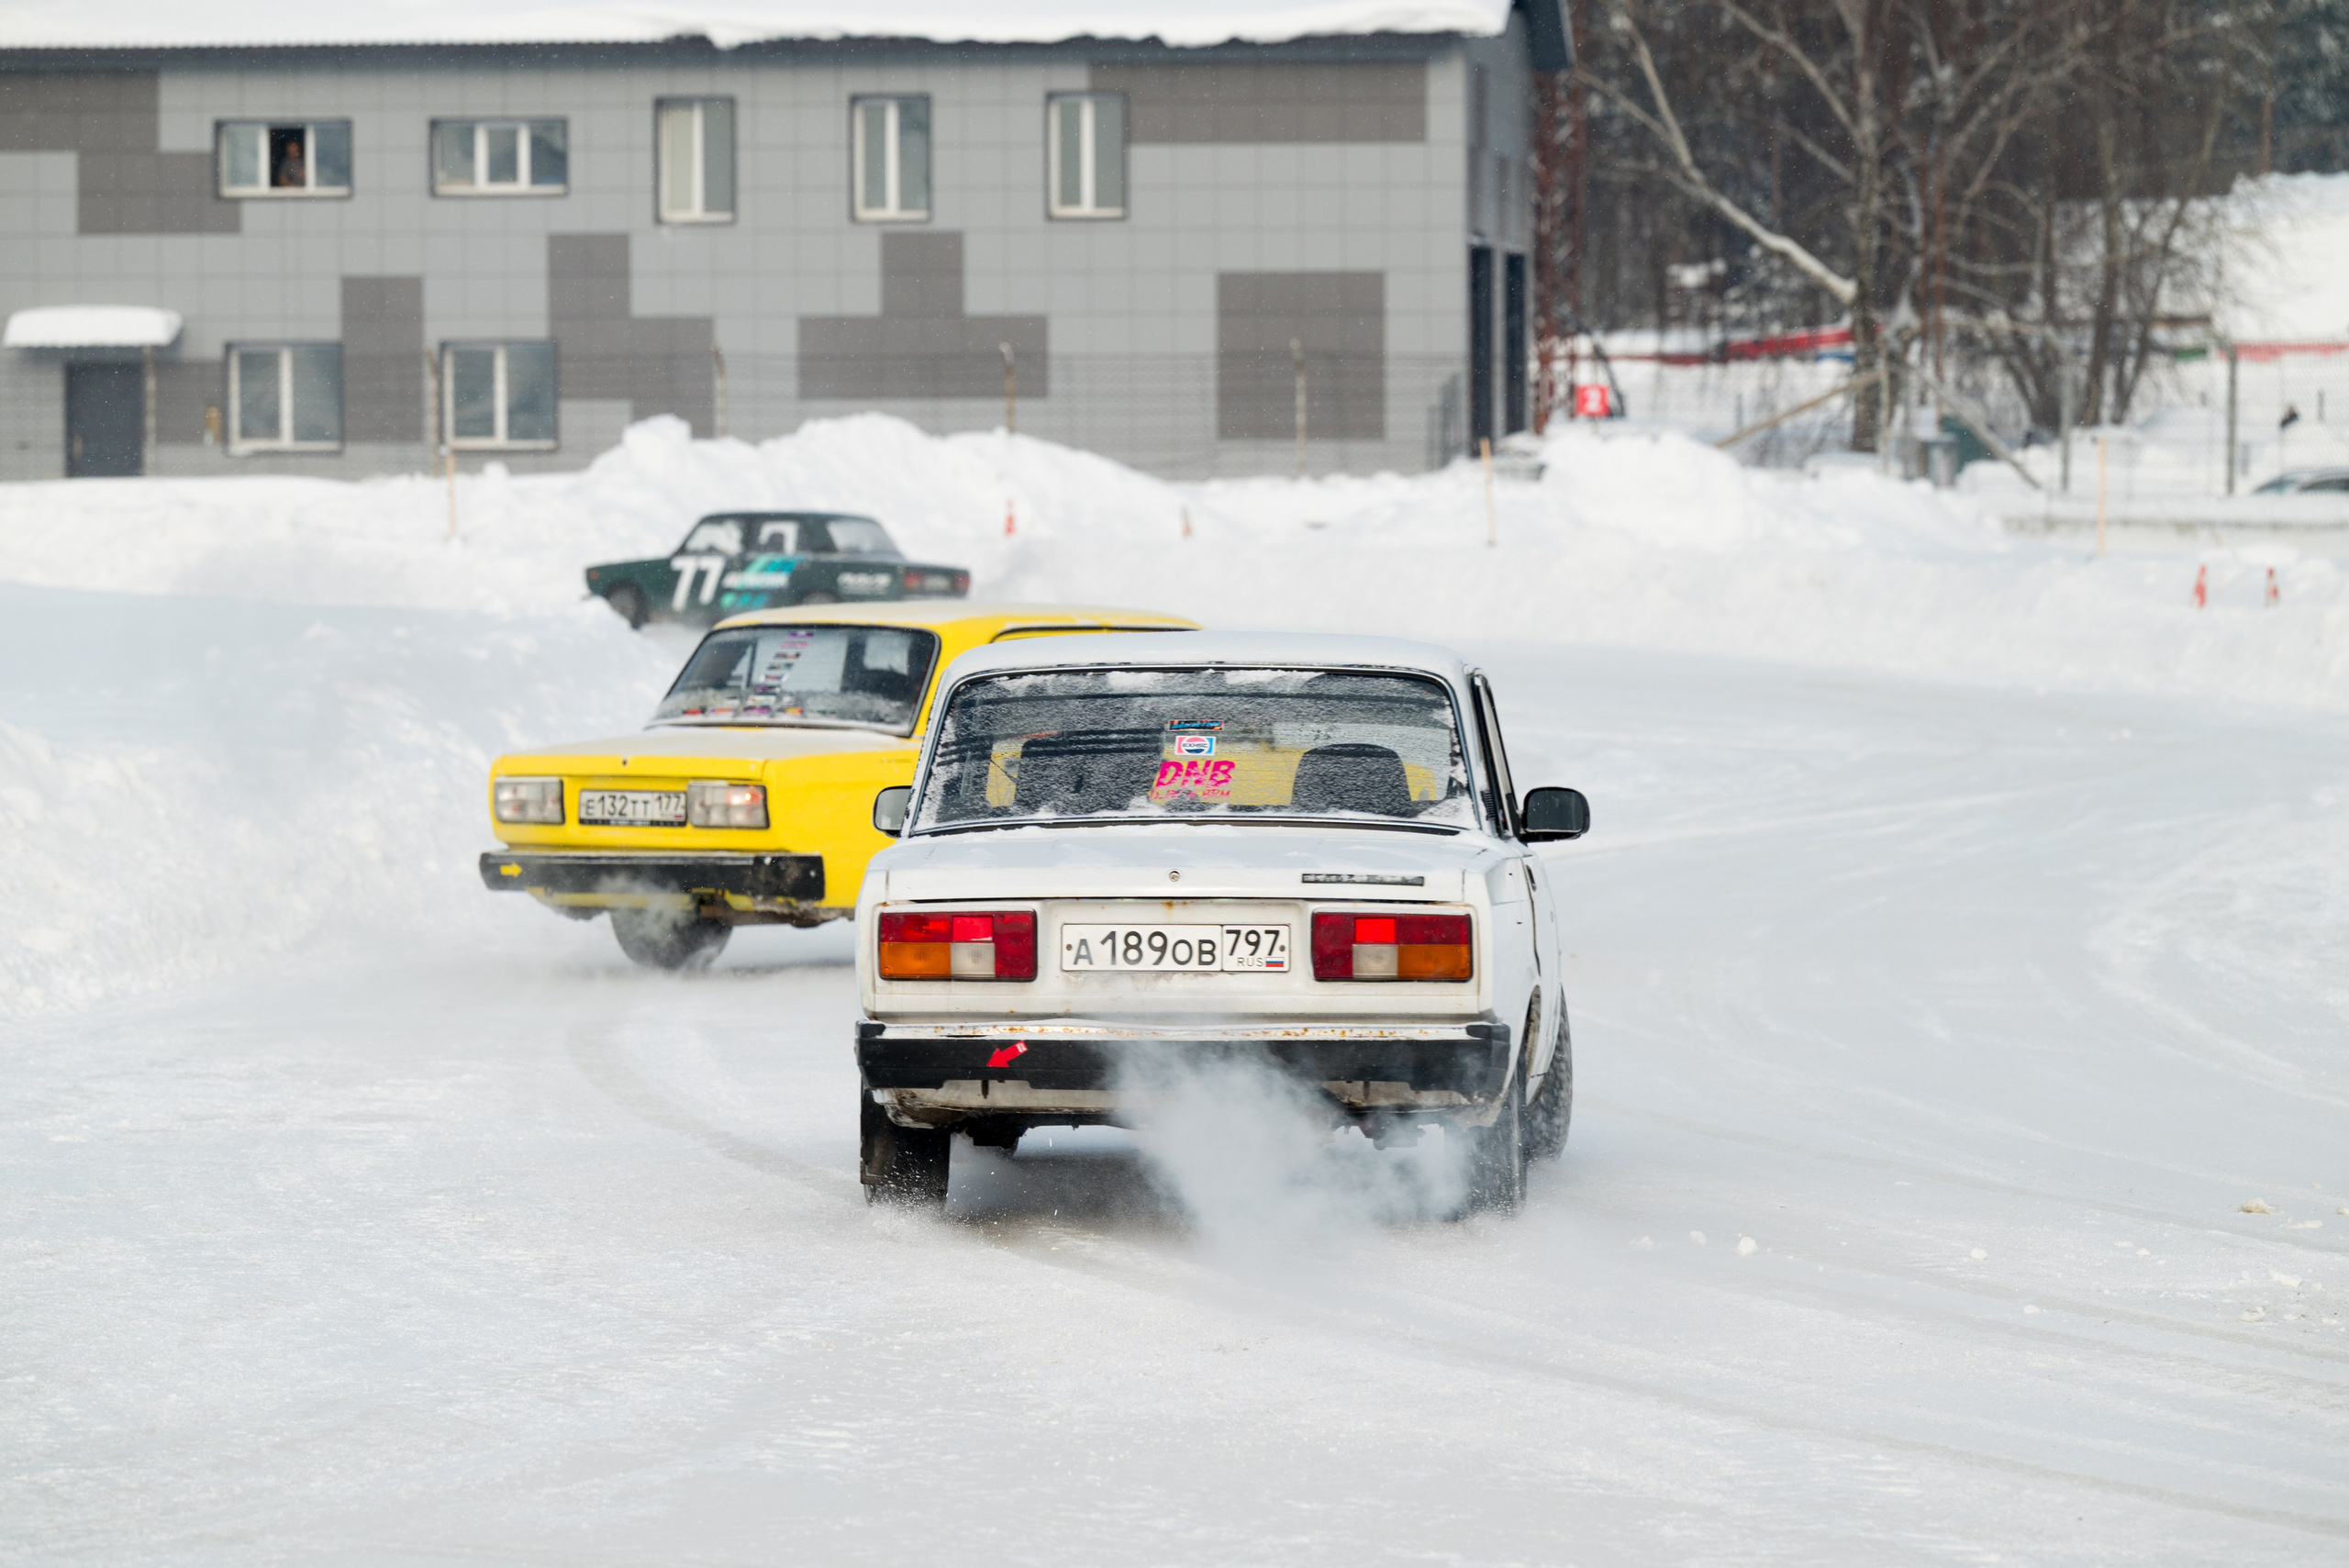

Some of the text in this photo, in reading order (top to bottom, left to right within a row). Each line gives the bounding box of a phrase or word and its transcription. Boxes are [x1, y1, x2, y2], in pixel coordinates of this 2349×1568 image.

[669, 555, 727, 613] 77
[1154, 760, 1236, 788] DNB
[584, 795, 682, 817] E132TT 177
[1073, 929, 1281, 966] A189OB 797
[1237, 957, 1264, 967] RUS
